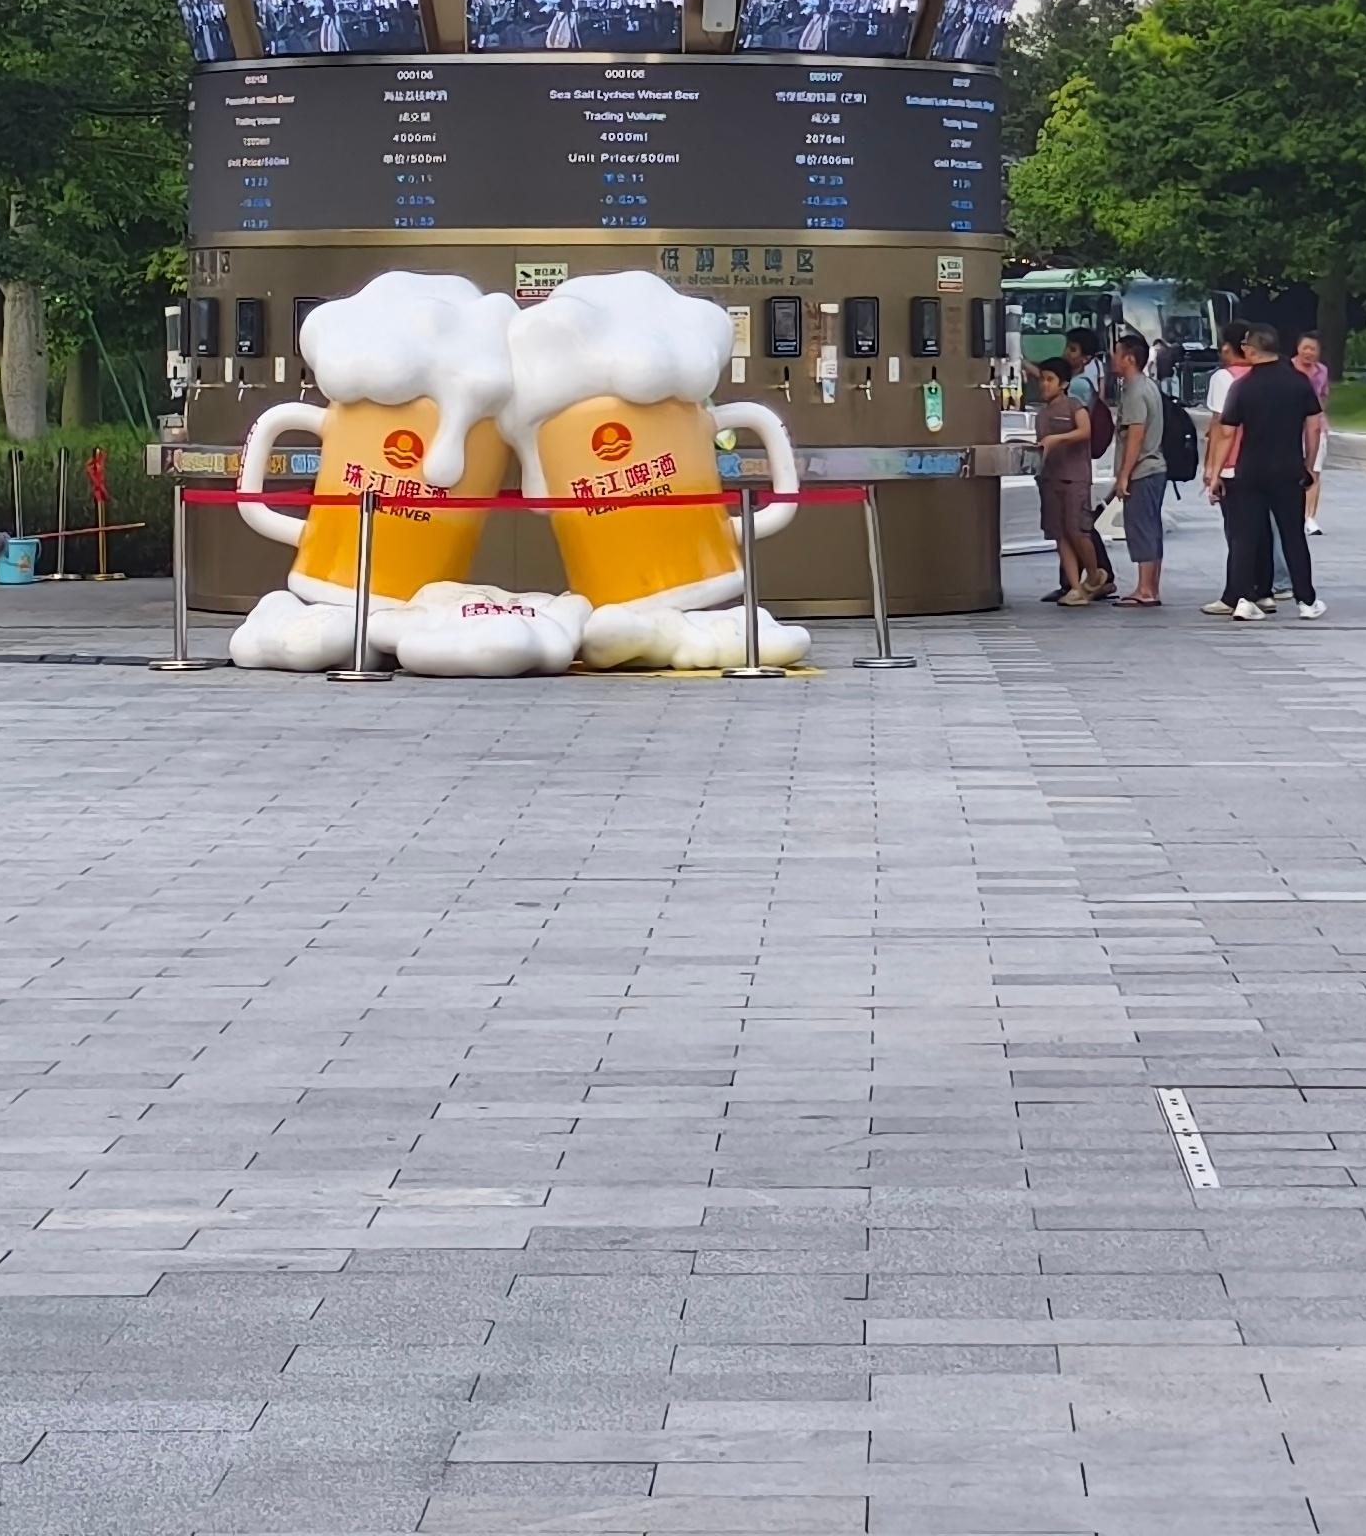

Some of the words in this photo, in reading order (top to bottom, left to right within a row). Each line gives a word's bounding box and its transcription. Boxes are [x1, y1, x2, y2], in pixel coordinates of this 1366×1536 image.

[550, 90, 571, 100] Sea
[574, 90, 594, 100] Salt
[637, 90, 672, 100] Wheat
[584, 111, 624, 123] Trading
[600, 132, 648, 142] 4000ml
[568, 153, 595, 163] Unit
[571, 453, 677, 498] 珠江啤酒
[390, 506, 432, 522] RIVER
